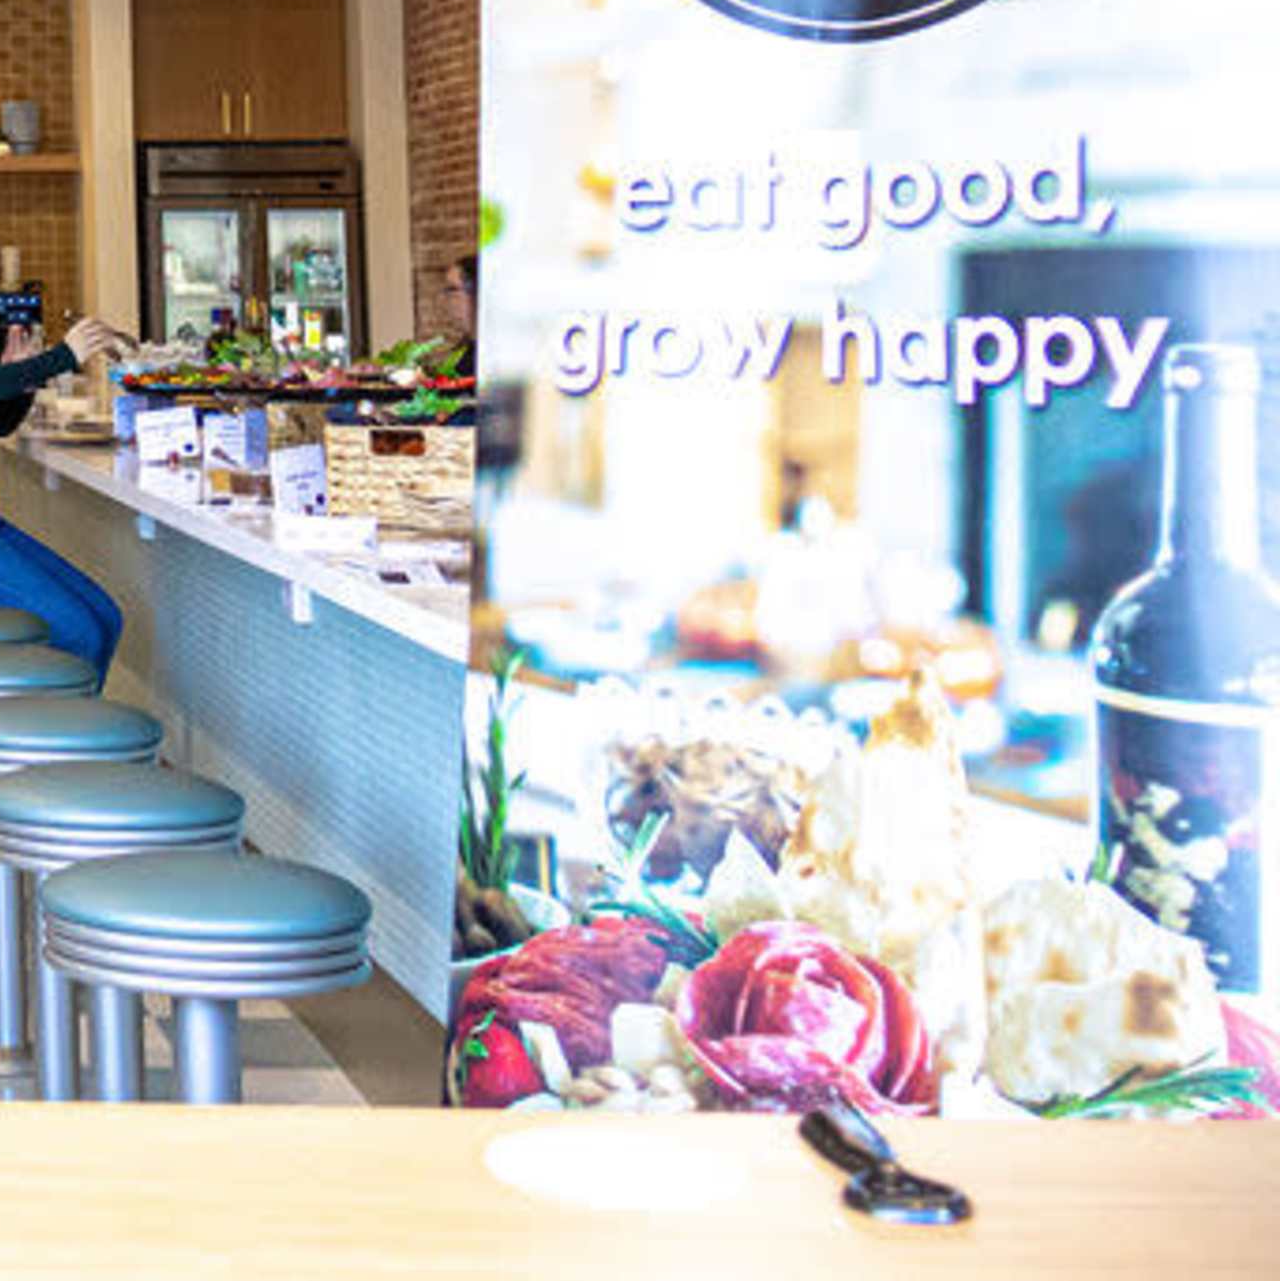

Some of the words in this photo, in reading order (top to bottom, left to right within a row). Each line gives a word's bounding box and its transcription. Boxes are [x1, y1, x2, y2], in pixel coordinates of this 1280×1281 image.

[616, 151, 785, 232] eat
[818, 132, 1120, 251] good,
[552, 309, 798, 397] grow
